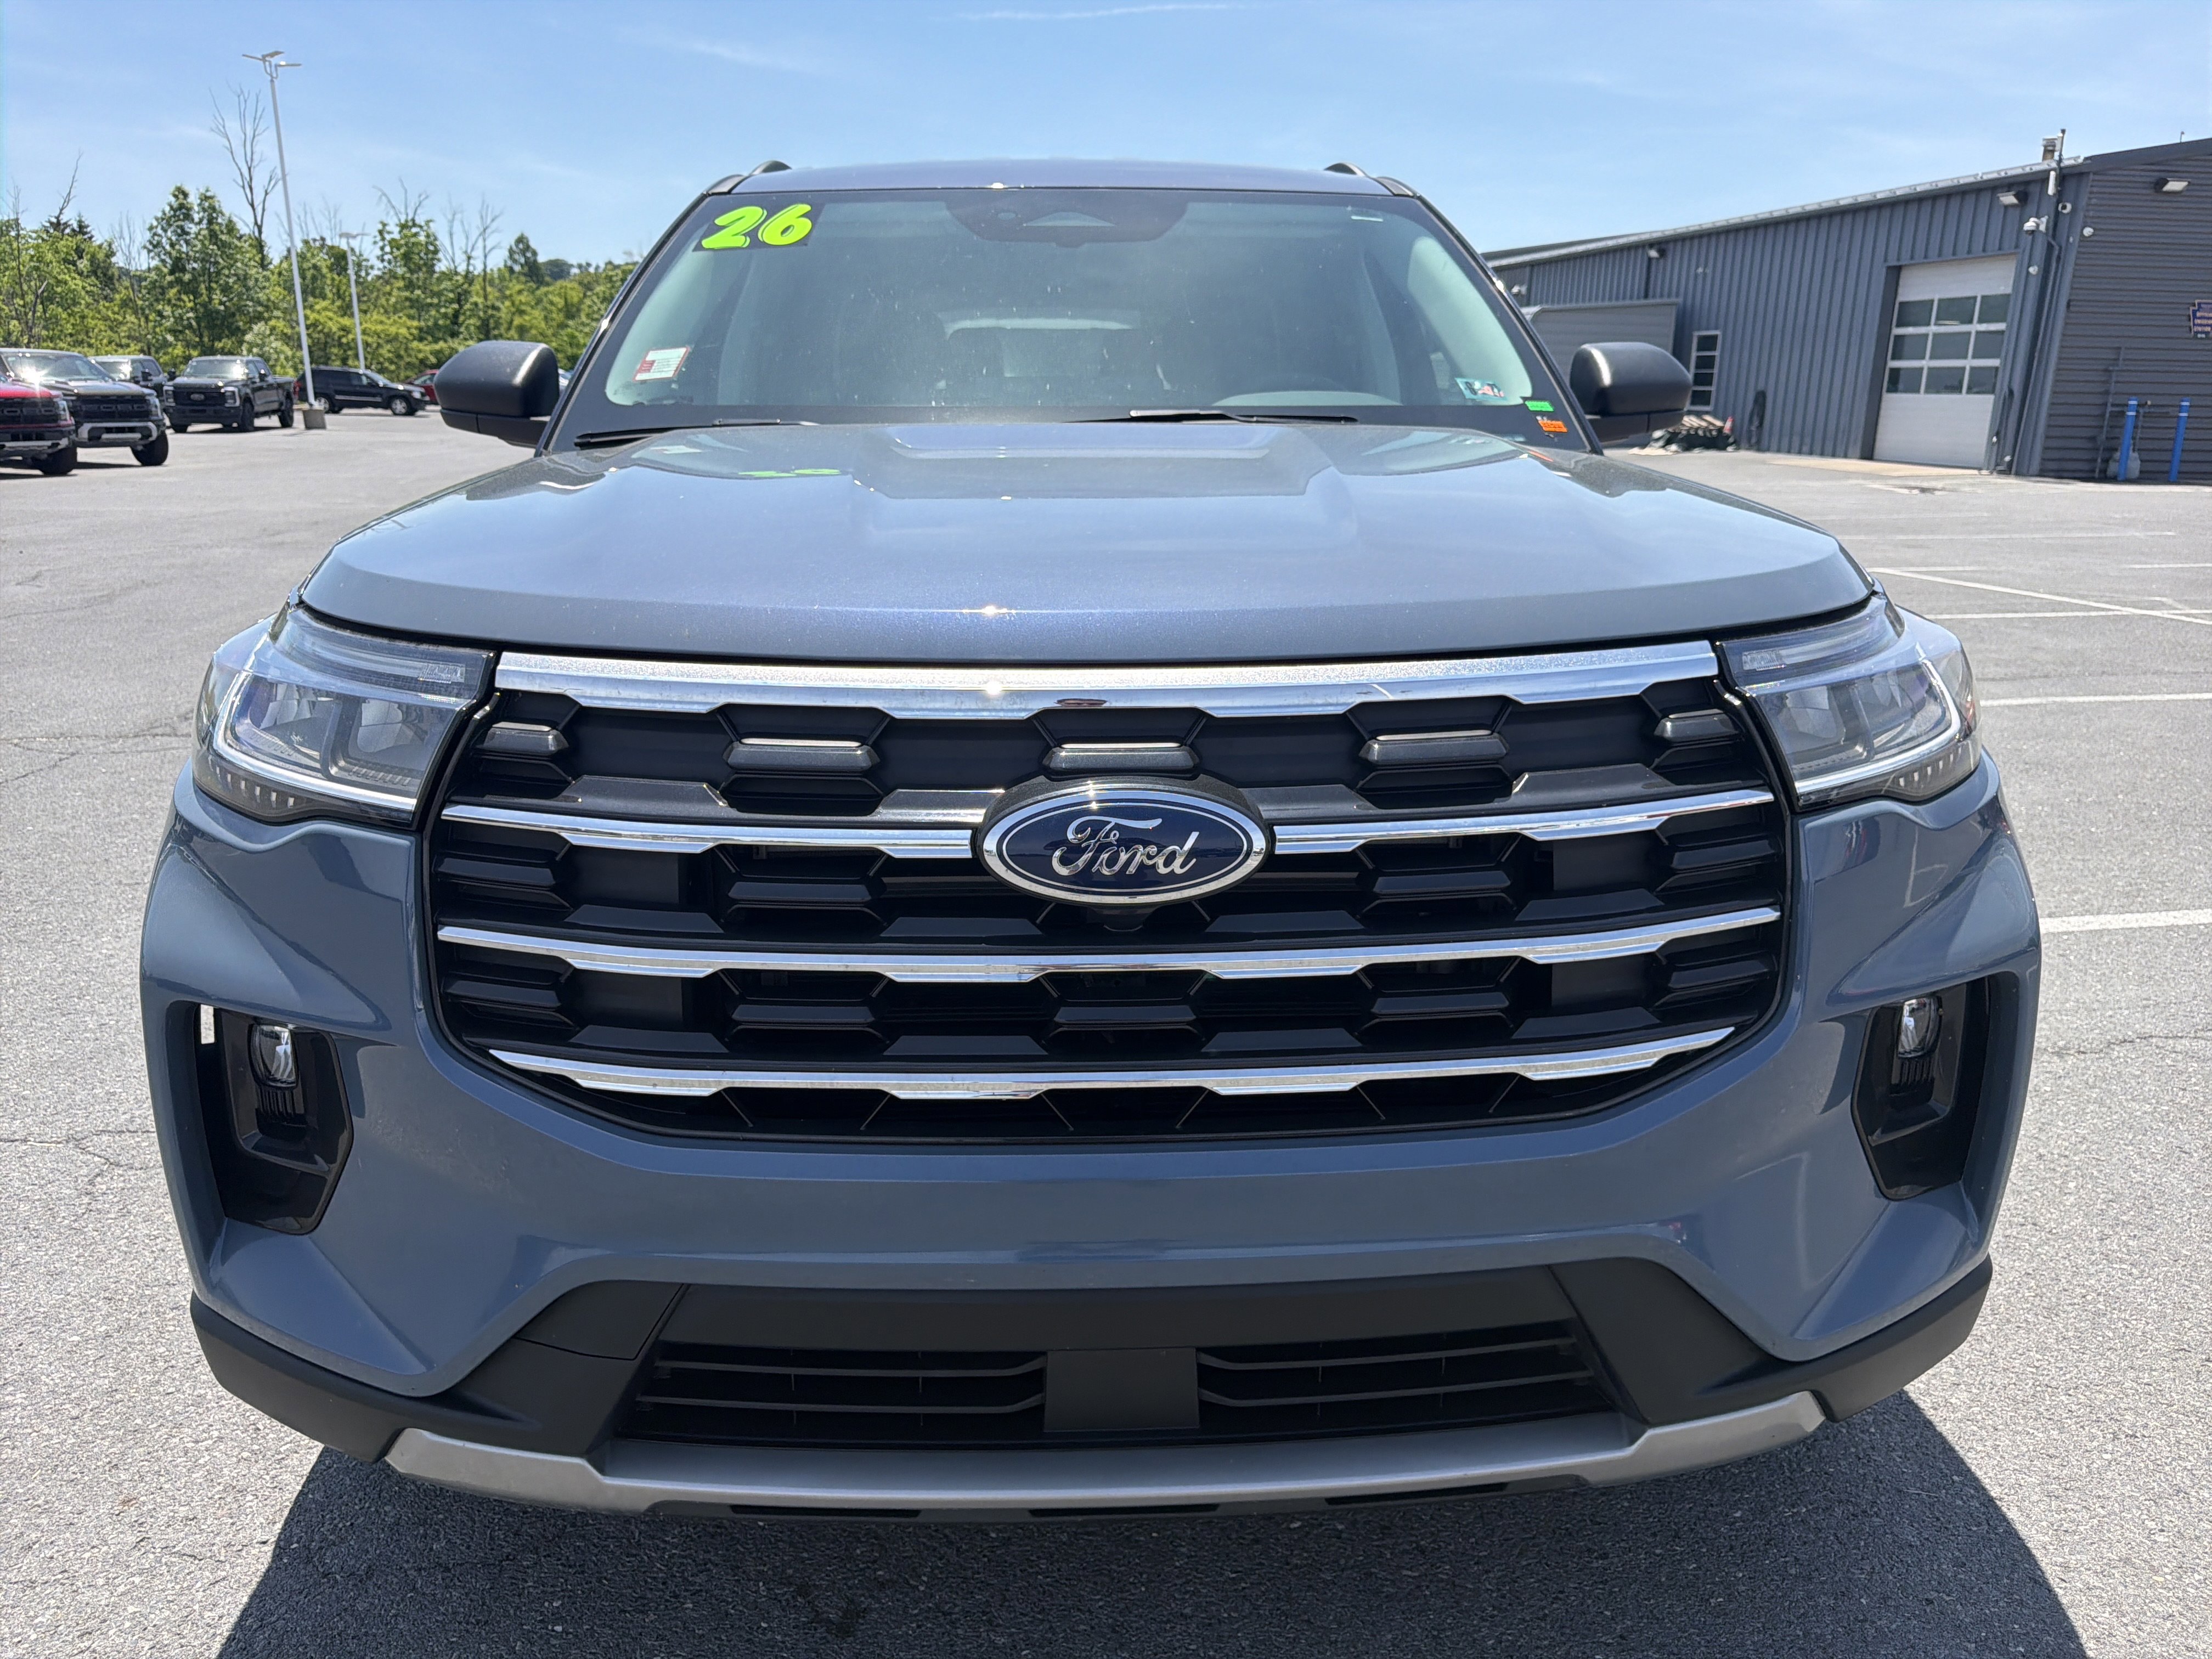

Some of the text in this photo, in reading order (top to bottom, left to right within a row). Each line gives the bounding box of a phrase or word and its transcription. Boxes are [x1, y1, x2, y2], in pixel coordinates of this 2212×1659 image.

[702, 204, 812, 249] 26
[0, 408, 55, 416] ORD
[1052, 815, 1200, 876] Ford
